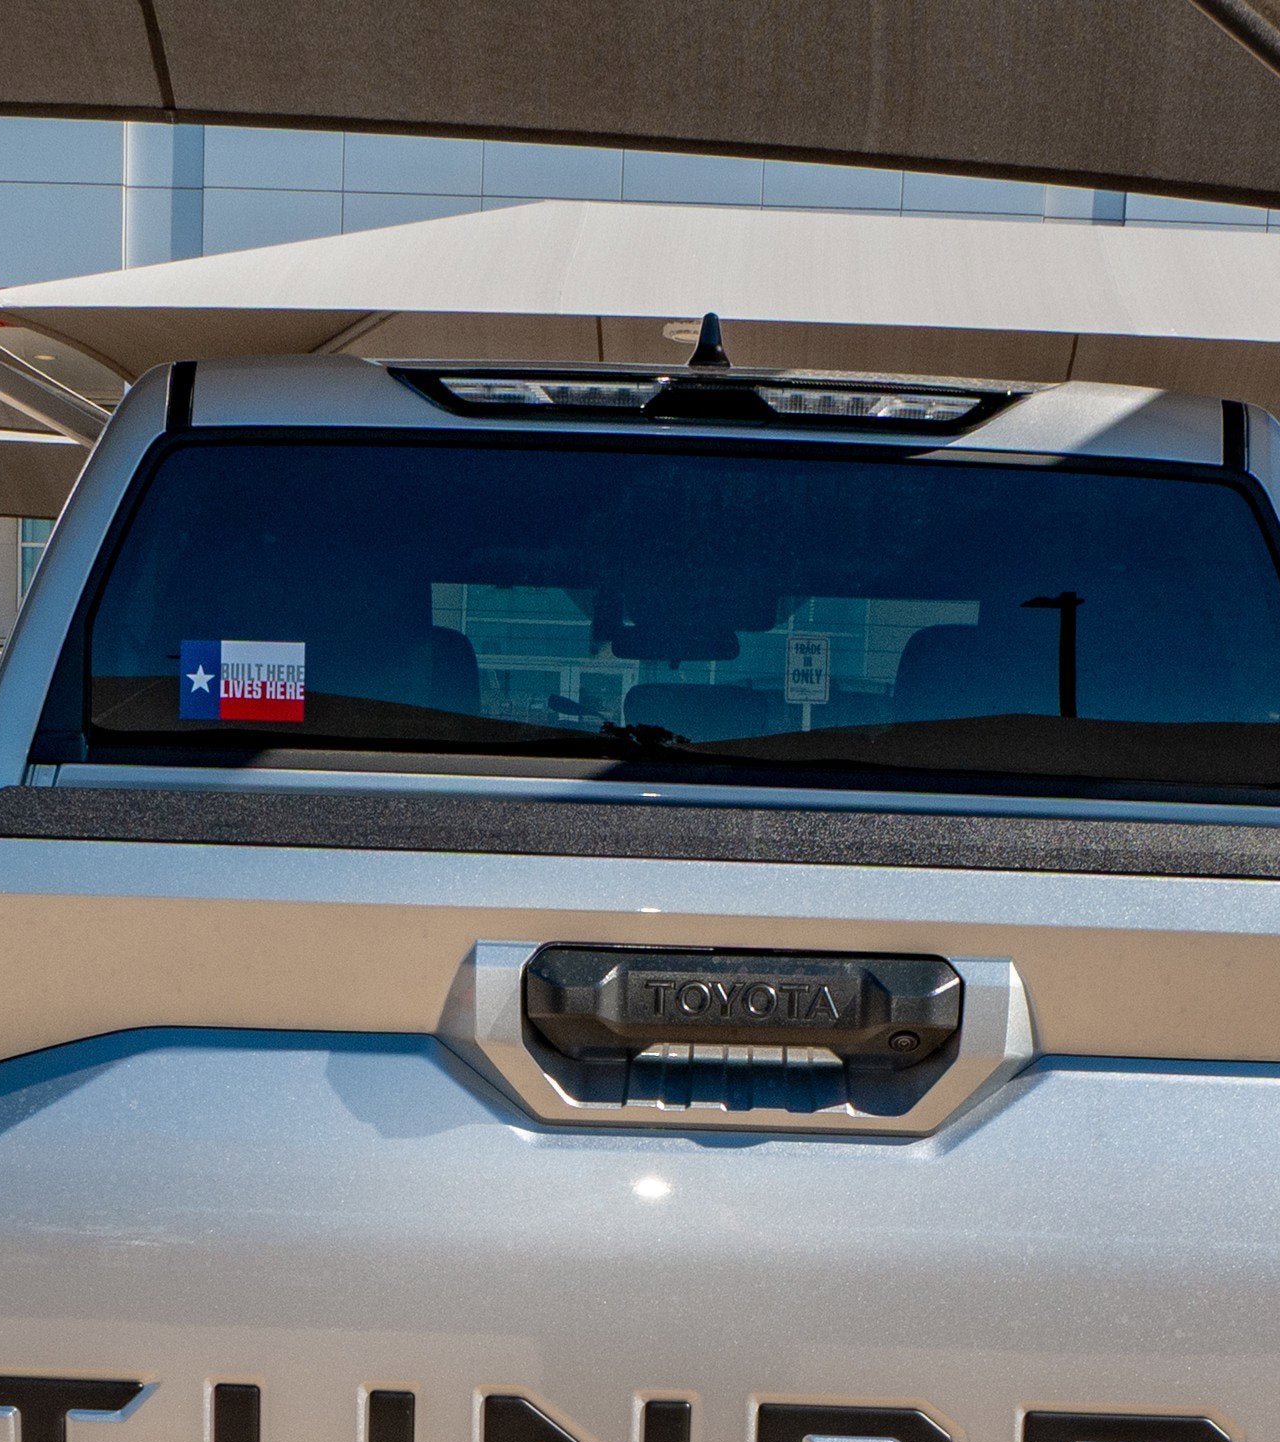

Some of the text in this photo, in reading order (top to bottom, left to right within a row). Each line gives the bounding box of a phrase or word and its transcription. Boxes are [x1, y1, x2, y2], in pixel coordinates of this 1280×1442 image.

[794, 643, 822, 654] TRADE
[221, 663, 305, 682] BUILT HERE
[792, 669, 822, 684] ONLY
[220, 680, 305, 700] LIVES HERE
[644, 978, 841, 1021] TOYOTA
